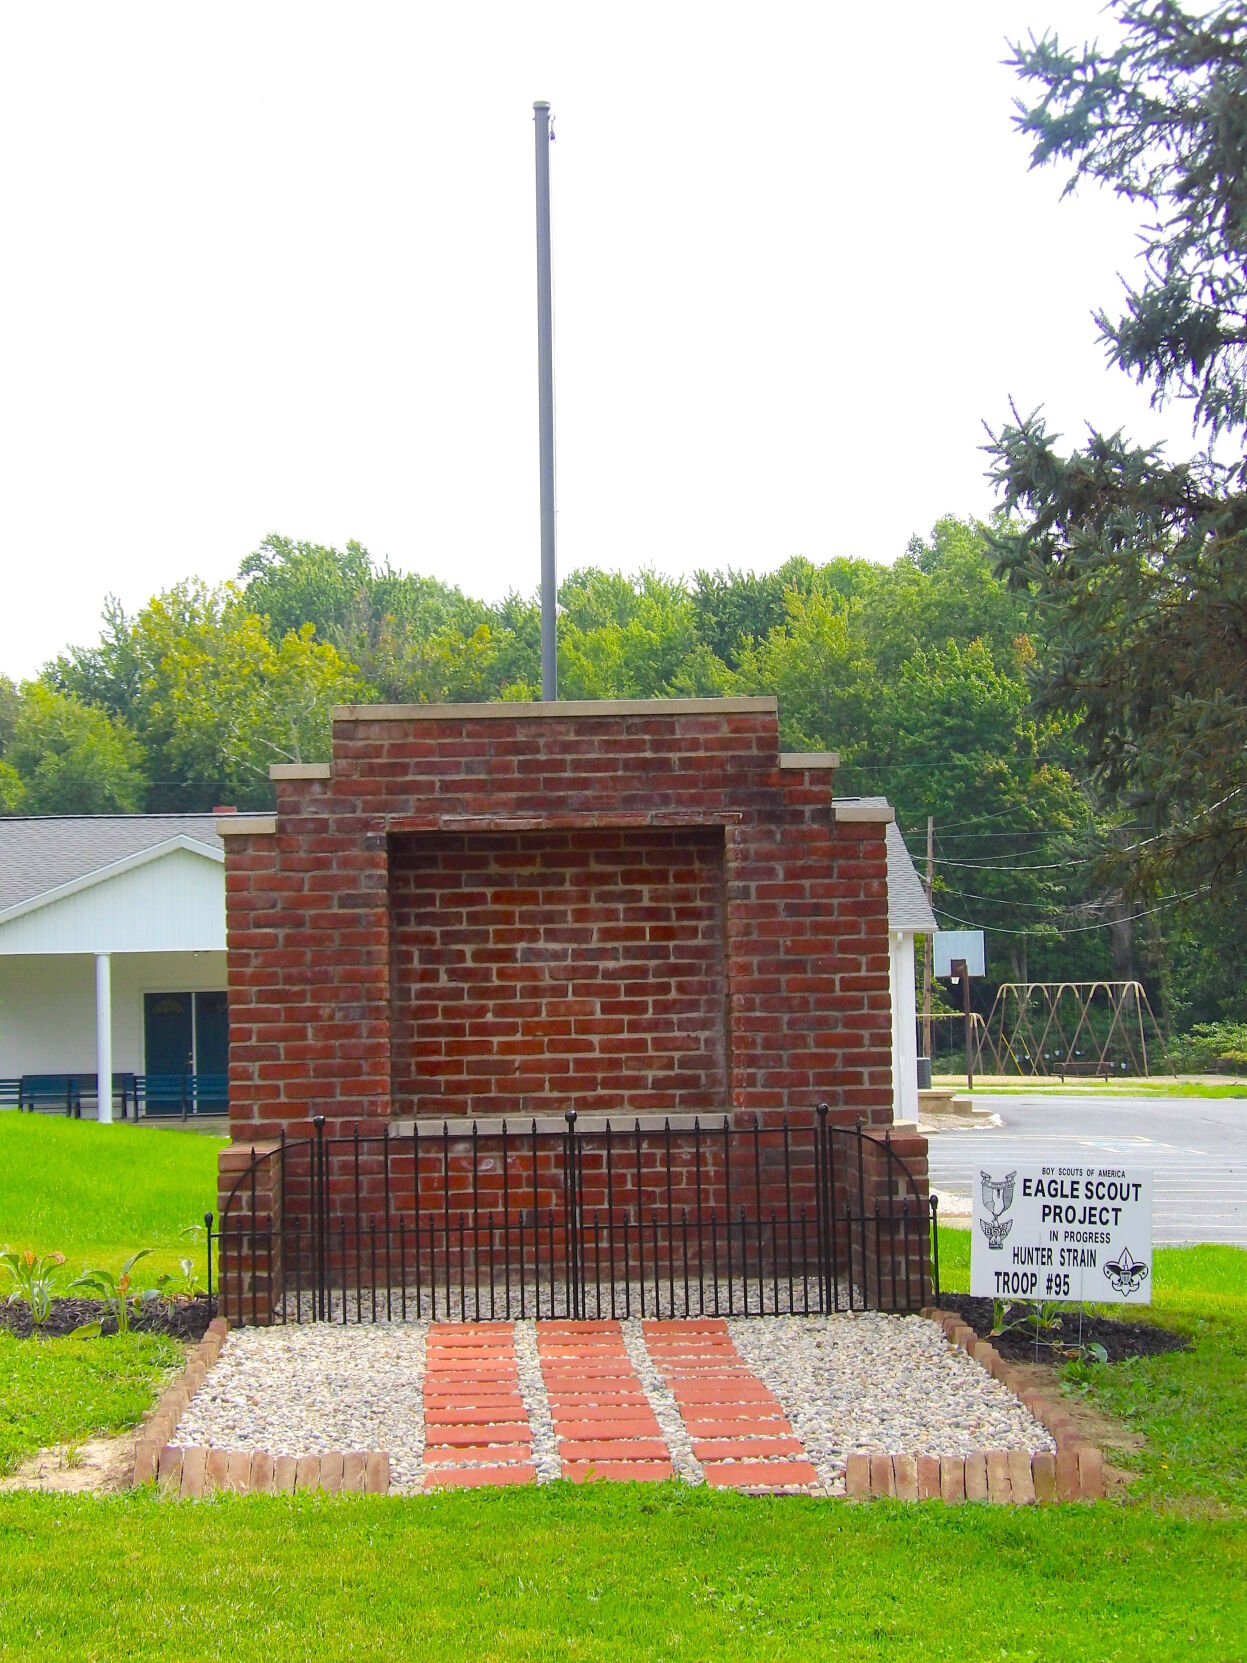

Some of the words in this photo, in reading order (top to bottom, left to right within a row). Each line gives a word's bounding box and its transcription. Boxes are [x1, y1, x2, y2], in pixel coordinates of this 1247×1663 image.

[1042, 1167, 1054, 1176] BOY
[1058, 1168, 1083, 1176] SCOUTS
[1087, 1169, 1095, 1177] OF
[1098, 1170, 1125, 1178] AMERICA
[1022, 1179, 1080, 1199] EAGLE
[1085, 1181, 1142, 1201] SCOUT
[1042, 1204, 1122, 1226] PROJECT
[1050, 1230, 1058, 1241] IN
[1064, 1231, 1111, 1243] PROGRESS
[1013, 1246, 1053, 1265] HUNTER
[1060, 1249, 1096, 1267] STRAIN
[995, 1271, 1037, 1294] TROOP
[1046, 1273, 1070, 1296] #95
